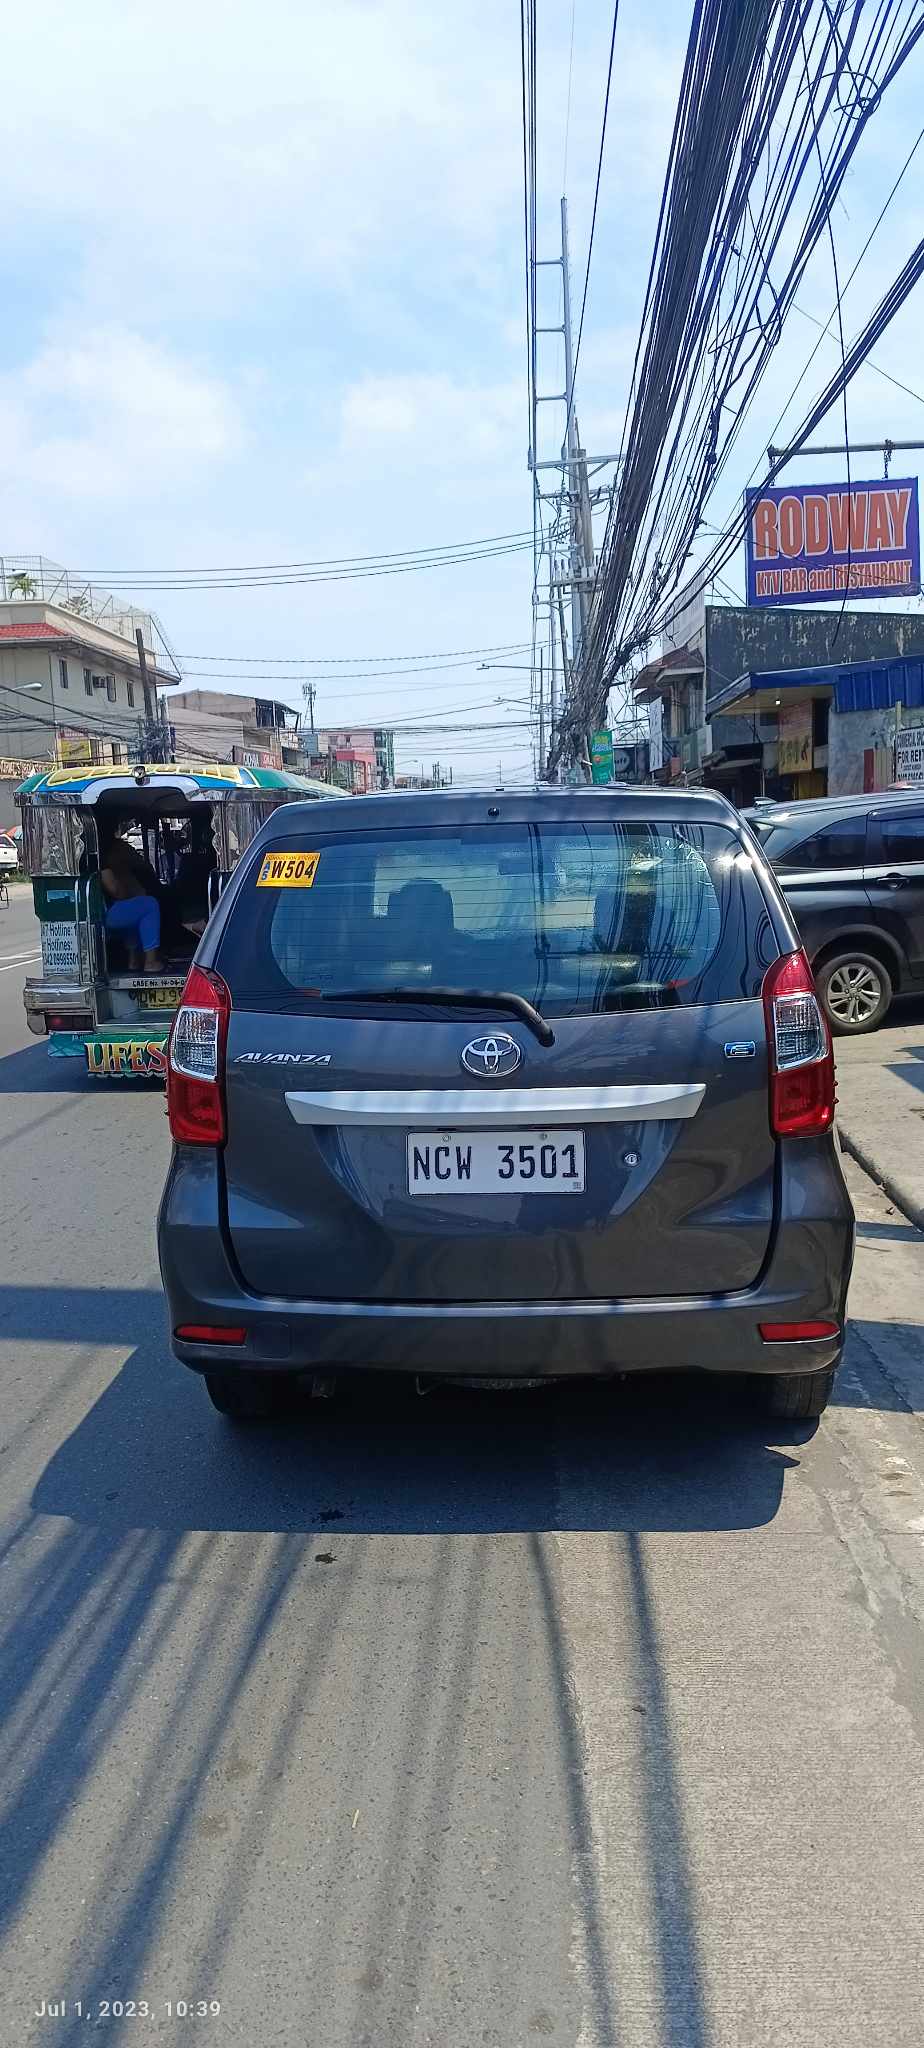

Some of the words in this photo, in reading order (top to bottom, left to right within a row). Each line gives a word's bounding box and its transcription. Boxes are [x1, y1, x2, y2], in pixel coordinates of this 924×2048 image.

[752, 488, 912, 560] RODWAY
[756, 570, 780, 597] KTV
[782, 567, 808, 594] BAR
[809, 565, 833, 592] and
[834, 559, 912, 590] RESTAURANT
[897, 751, 909, 764] FOR
[271, 860, 315, 879] W504
[49, 922, 72, 937] Hotline:
[46, 938, 72, 952] Hotlines:
[233, 1052, 332, 1066] AVANZA
[413, 1146, 472, 1180] NCW
[498, 1144, 579, 1179] 3501
